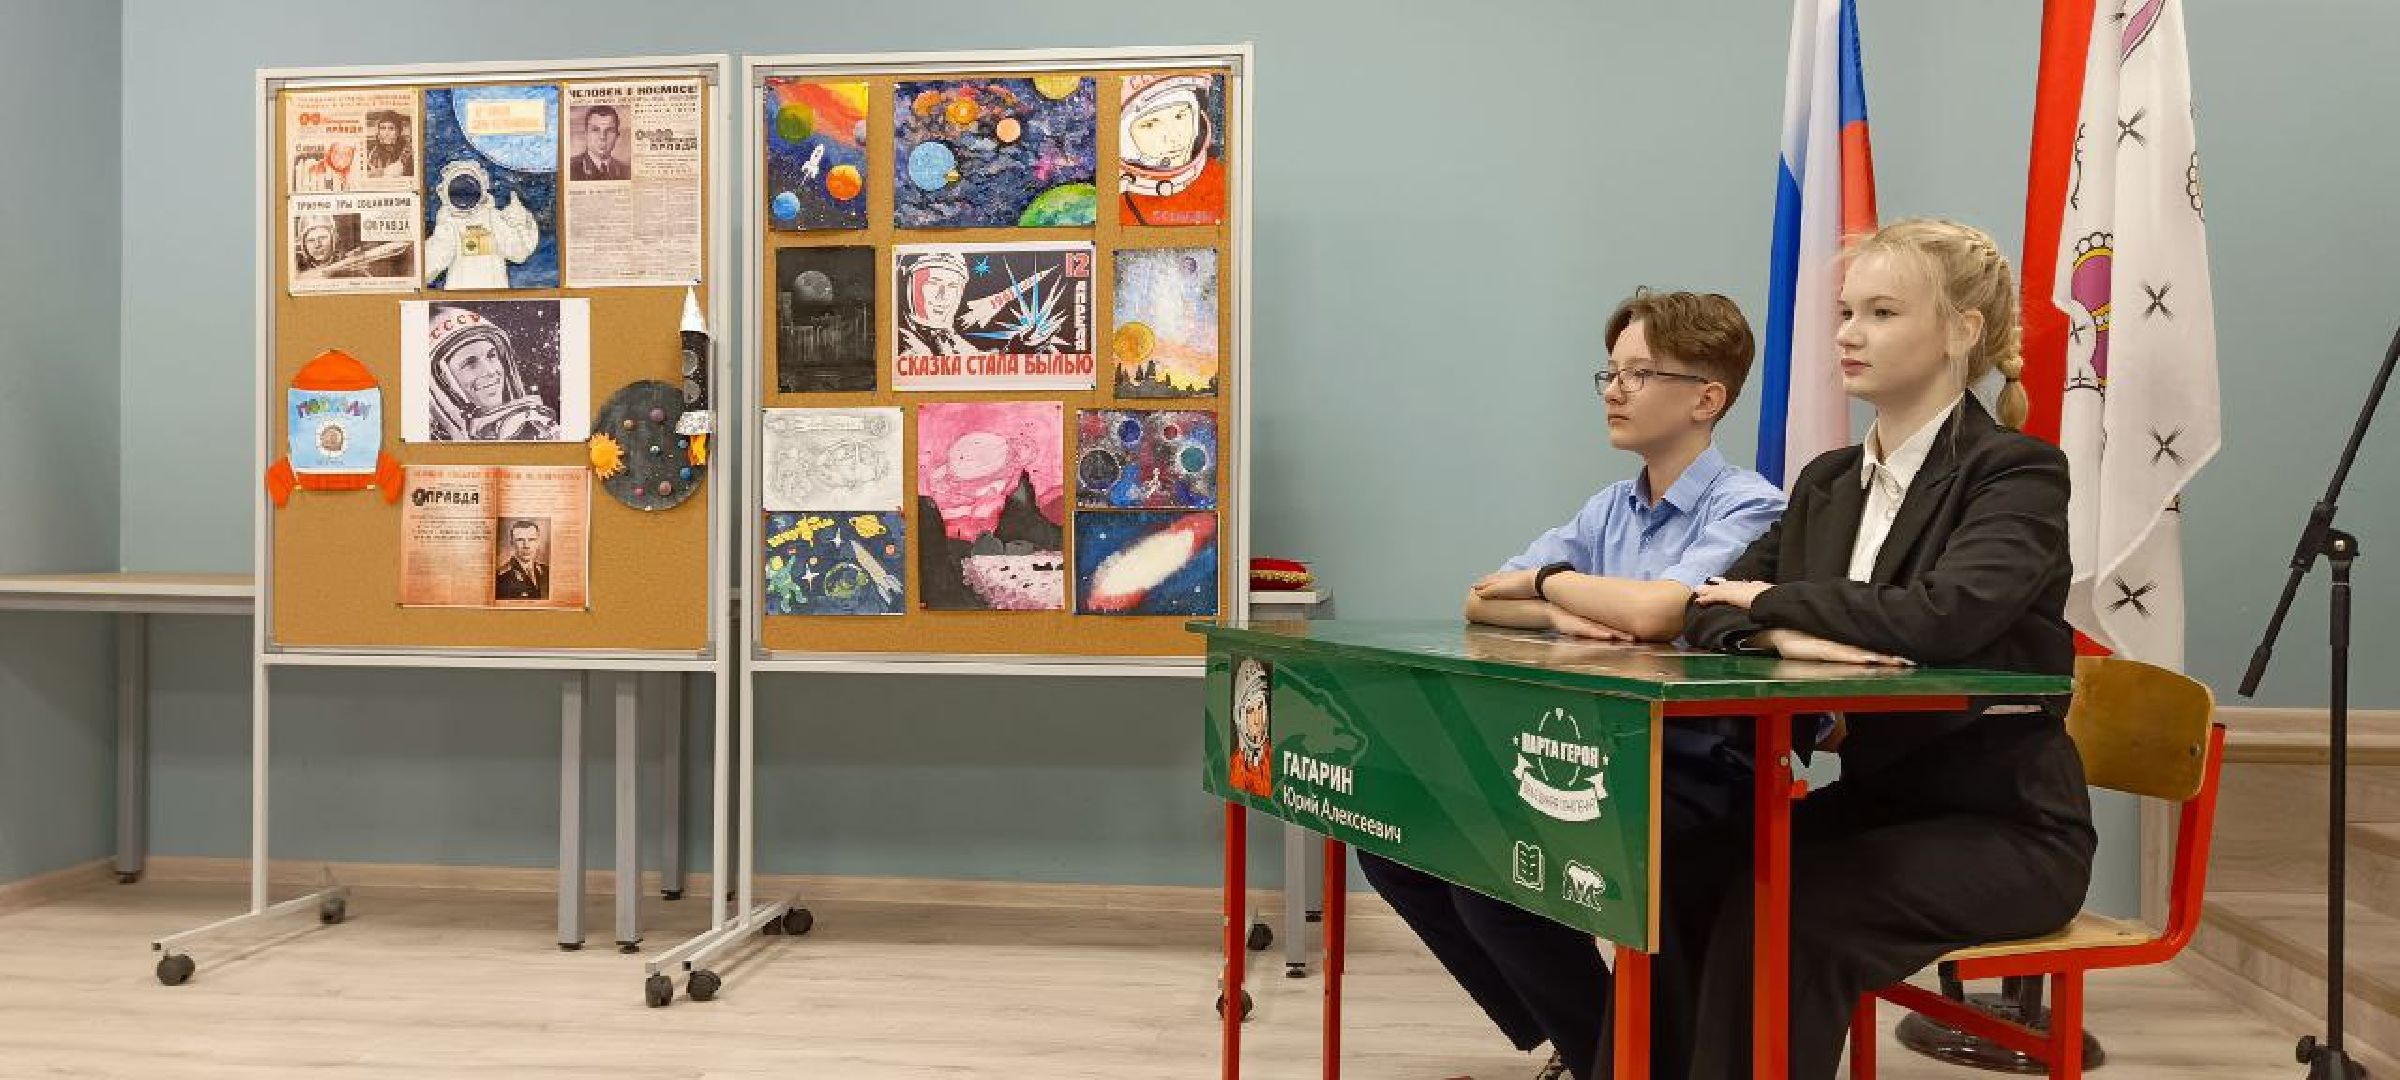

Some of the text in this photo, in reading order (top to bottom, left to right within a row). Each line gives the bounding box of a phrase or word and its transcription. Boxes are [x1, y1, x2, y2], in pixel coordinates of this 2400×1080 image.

[1066, 252, 1090, 277] 12
[1074, 280, 1087, 351] АПРЕЛЯ
[897, 354, 1094, 376] СКАЗКА СТАЛА БЫЛЬЮ
[426, 490, 479, 505] ПРАВДА
[1521, 732, 1600, 769] ПАРТА ГЕРОЯ
[1283, 750, 1354, 796] ГАГАРИН
[1283, 784, 1401, 844] Юрий Алексеевич
